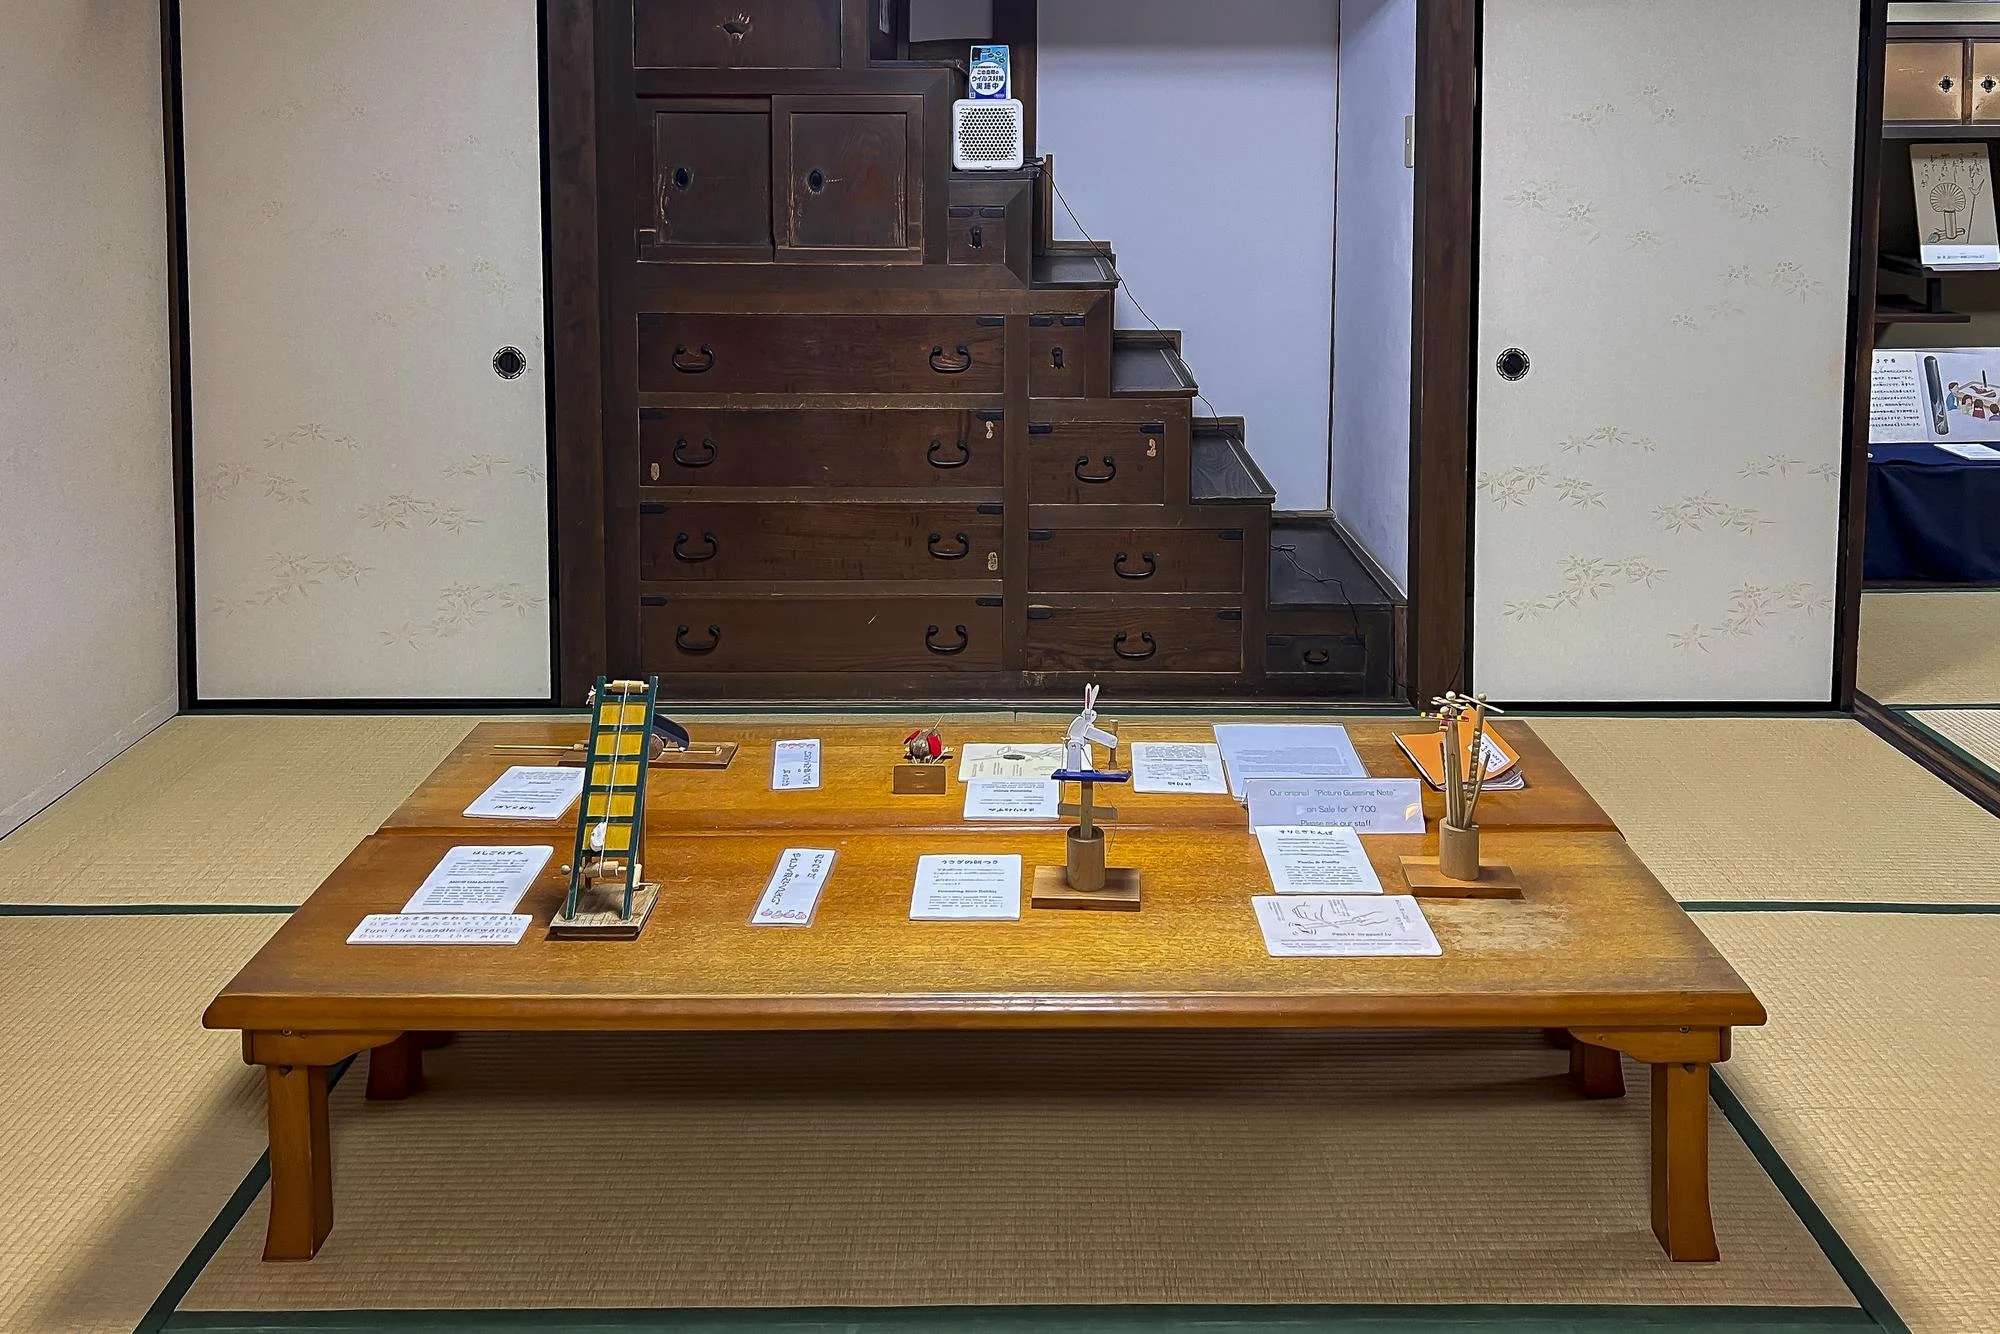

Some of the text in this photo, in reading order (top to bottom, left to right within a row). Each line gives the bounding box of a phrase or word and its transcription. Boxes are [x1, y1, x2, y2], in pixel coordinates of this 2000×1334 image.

[1284, 789, 1310, 797] original
[1343, 789, 1375, 797] Guessing
[1318, 805, 1336, 813] Sale
[1337, 805, 1348, 813] for
[1354, 819, 1371, 827] staff
